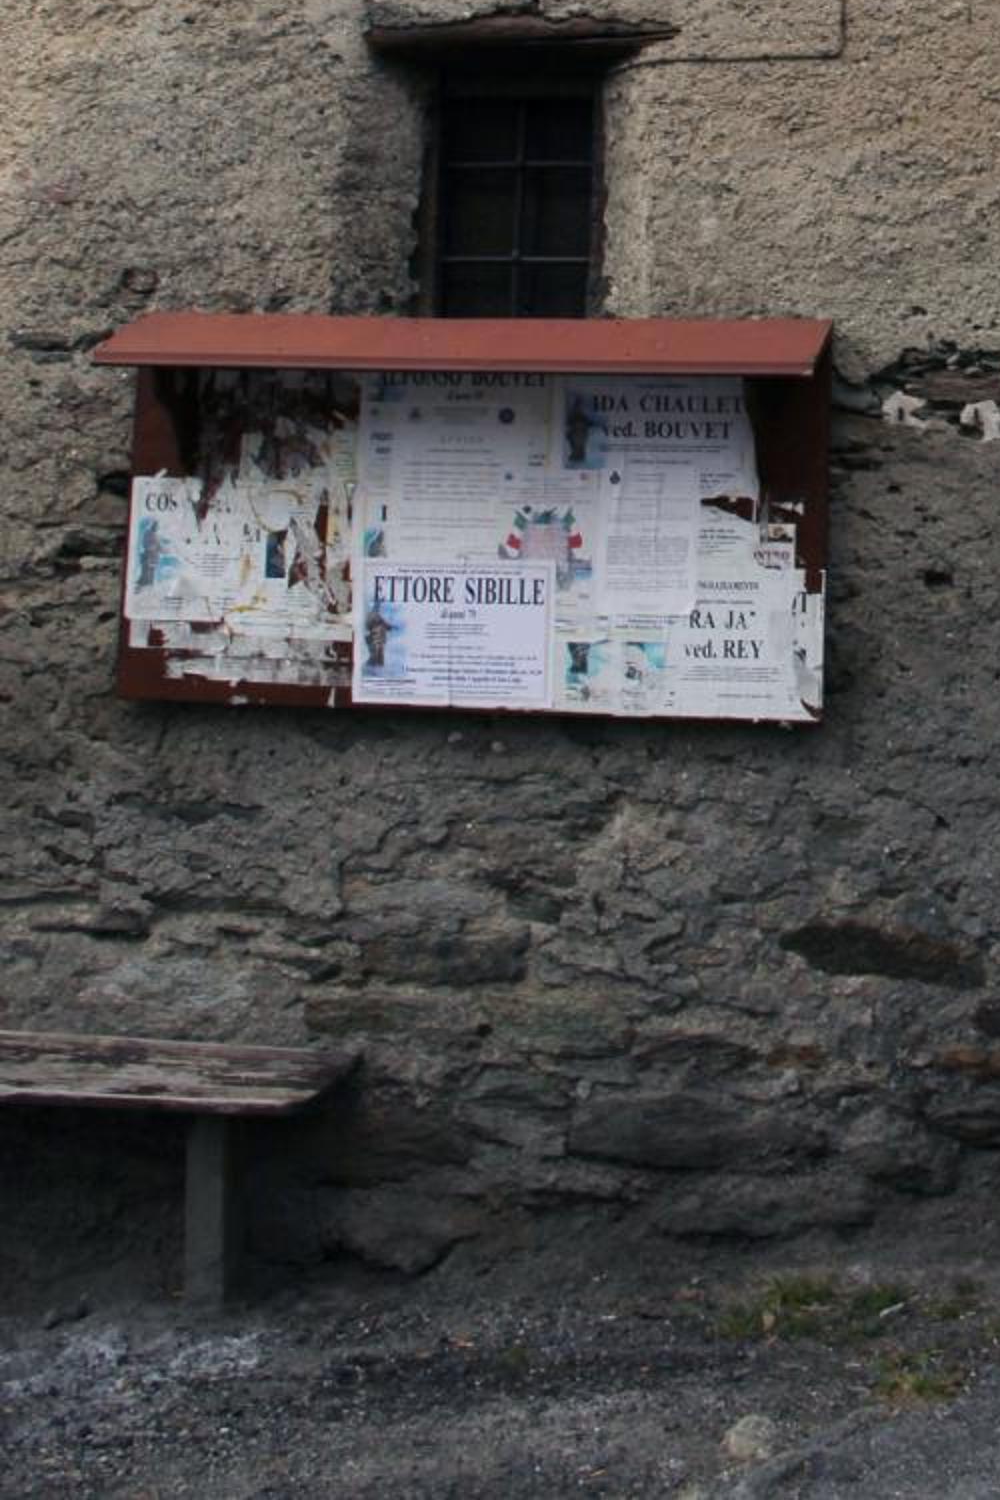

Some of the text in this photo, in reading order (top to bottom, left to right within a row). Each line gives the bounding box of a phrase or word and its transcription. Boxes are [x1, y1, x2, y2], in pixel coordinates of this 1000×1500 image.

[592, 395, 744, 414] IDA CHAULET
[644, 421, 733, 439] BOUVET
[374, 575, 545, 606] ETTORE SIBILLE
[684, 639, 764, 659] ved. REY
